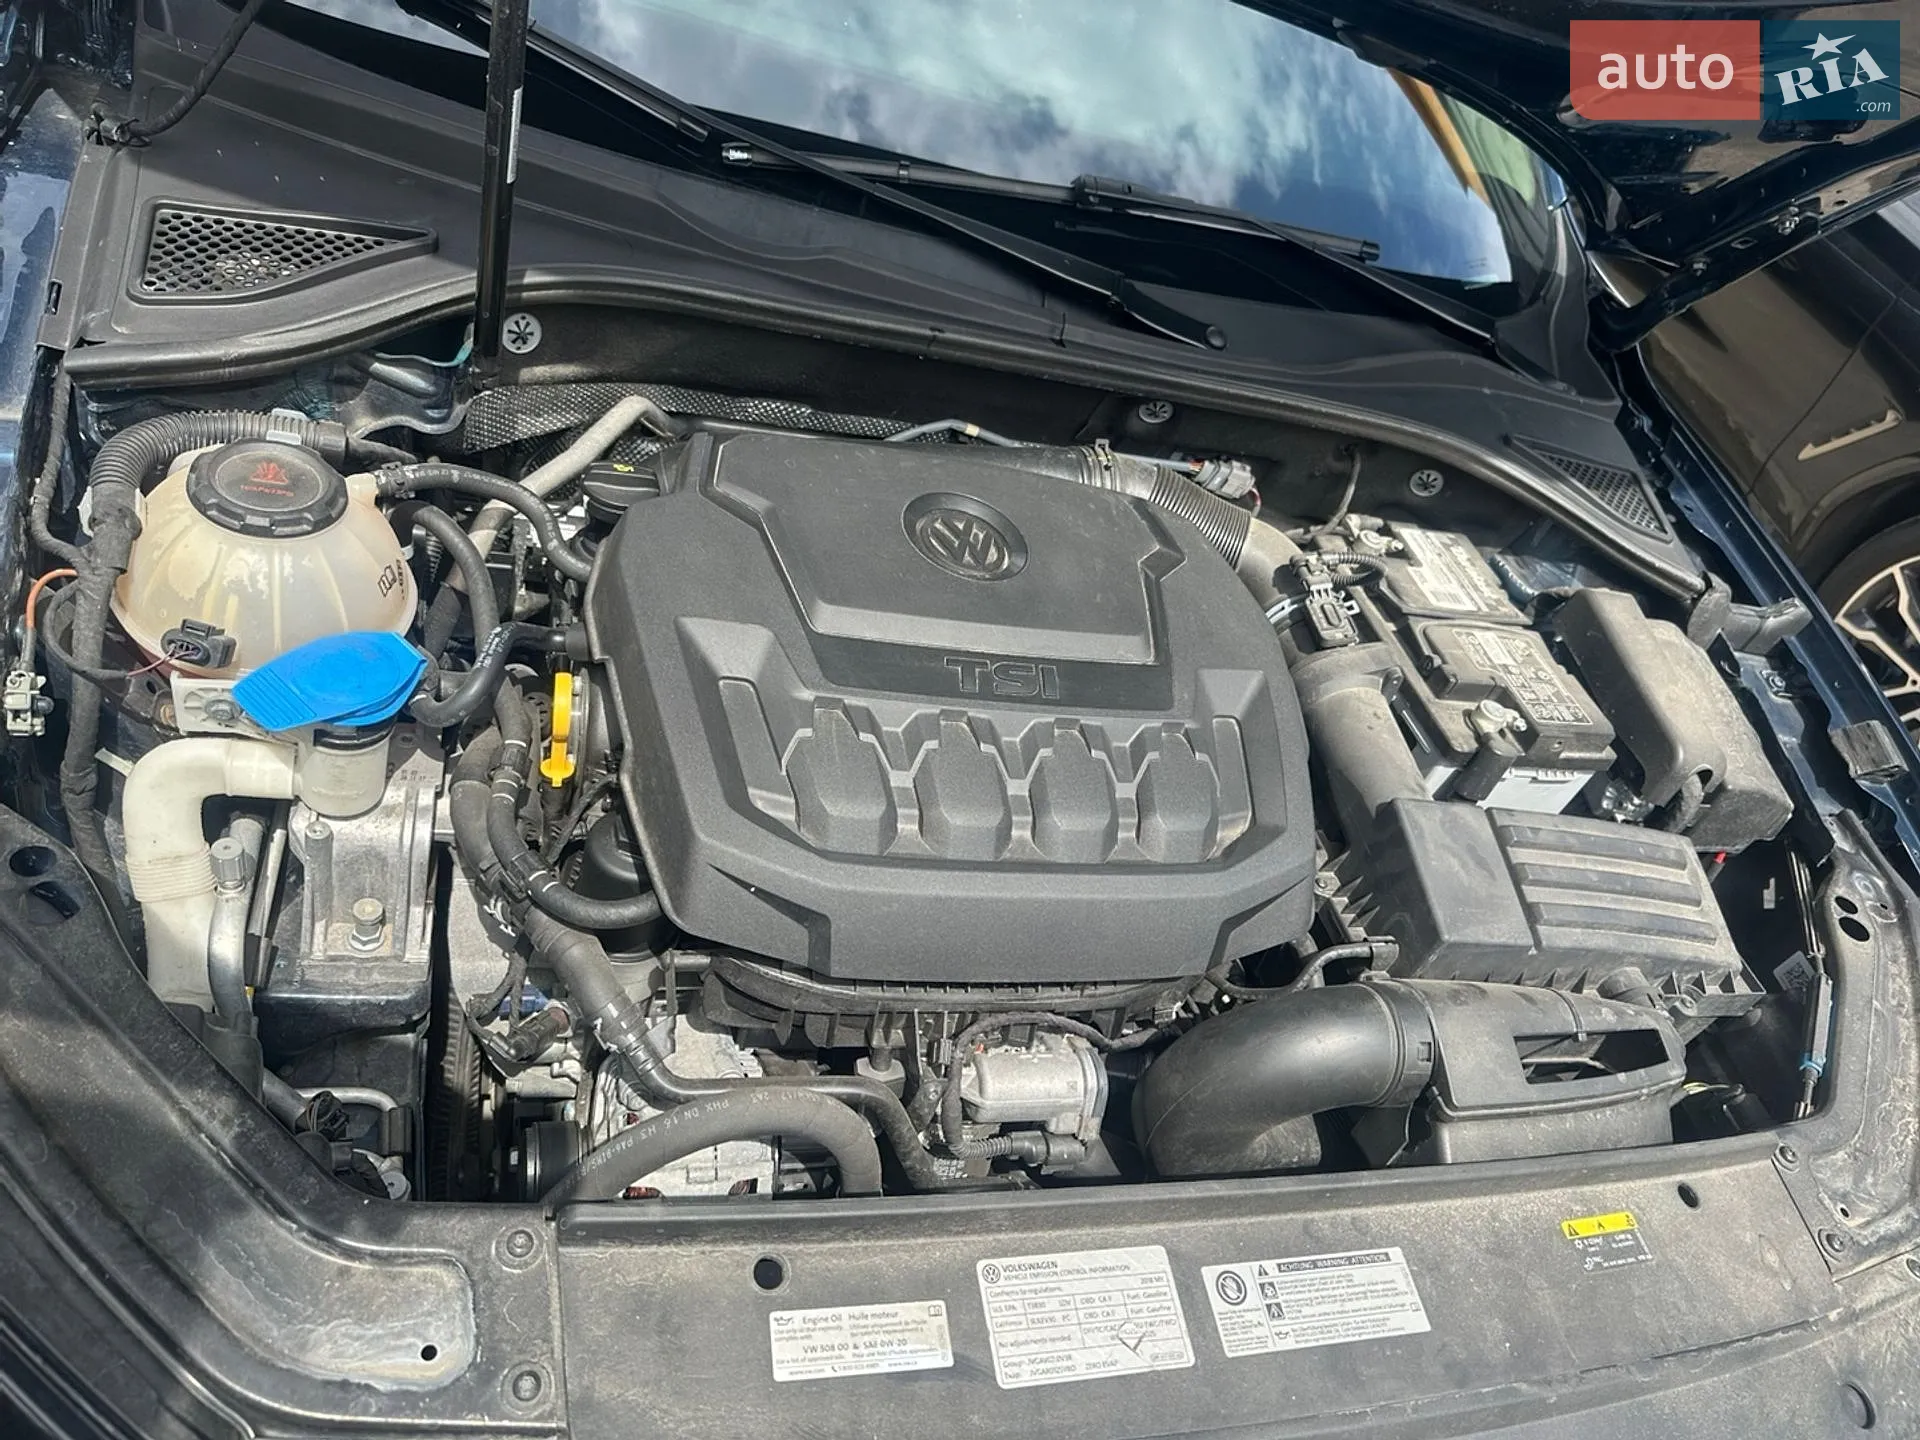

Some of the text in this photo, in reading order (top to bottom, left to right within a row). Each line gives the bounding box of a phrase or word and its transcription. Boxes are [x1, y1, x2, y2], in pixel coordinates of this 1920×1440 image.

[944, 656, 1060, 699] TSI
[1001, 1260, 1058, 1273] VOLKSWAGEN
[1316, 1258, 1348, 1268] WARNING
[1352, 1254, 1387, 1264] ATTENTION
[1029, 1270, 1059, 1280] EMISSION
[1060, 1267, 1087, 1277] CONTROL
[1089, 1264, 1131, 1273] INFORMATION
[802, 1313, 842, 1326] Engine Oil
[848, 1311, 898, 1321] Huile moteur
[802, 1344, 818, 1354] VW
[837, 1342, 849, 1351] 00
[863, 1341, 878, 1349] SAE
